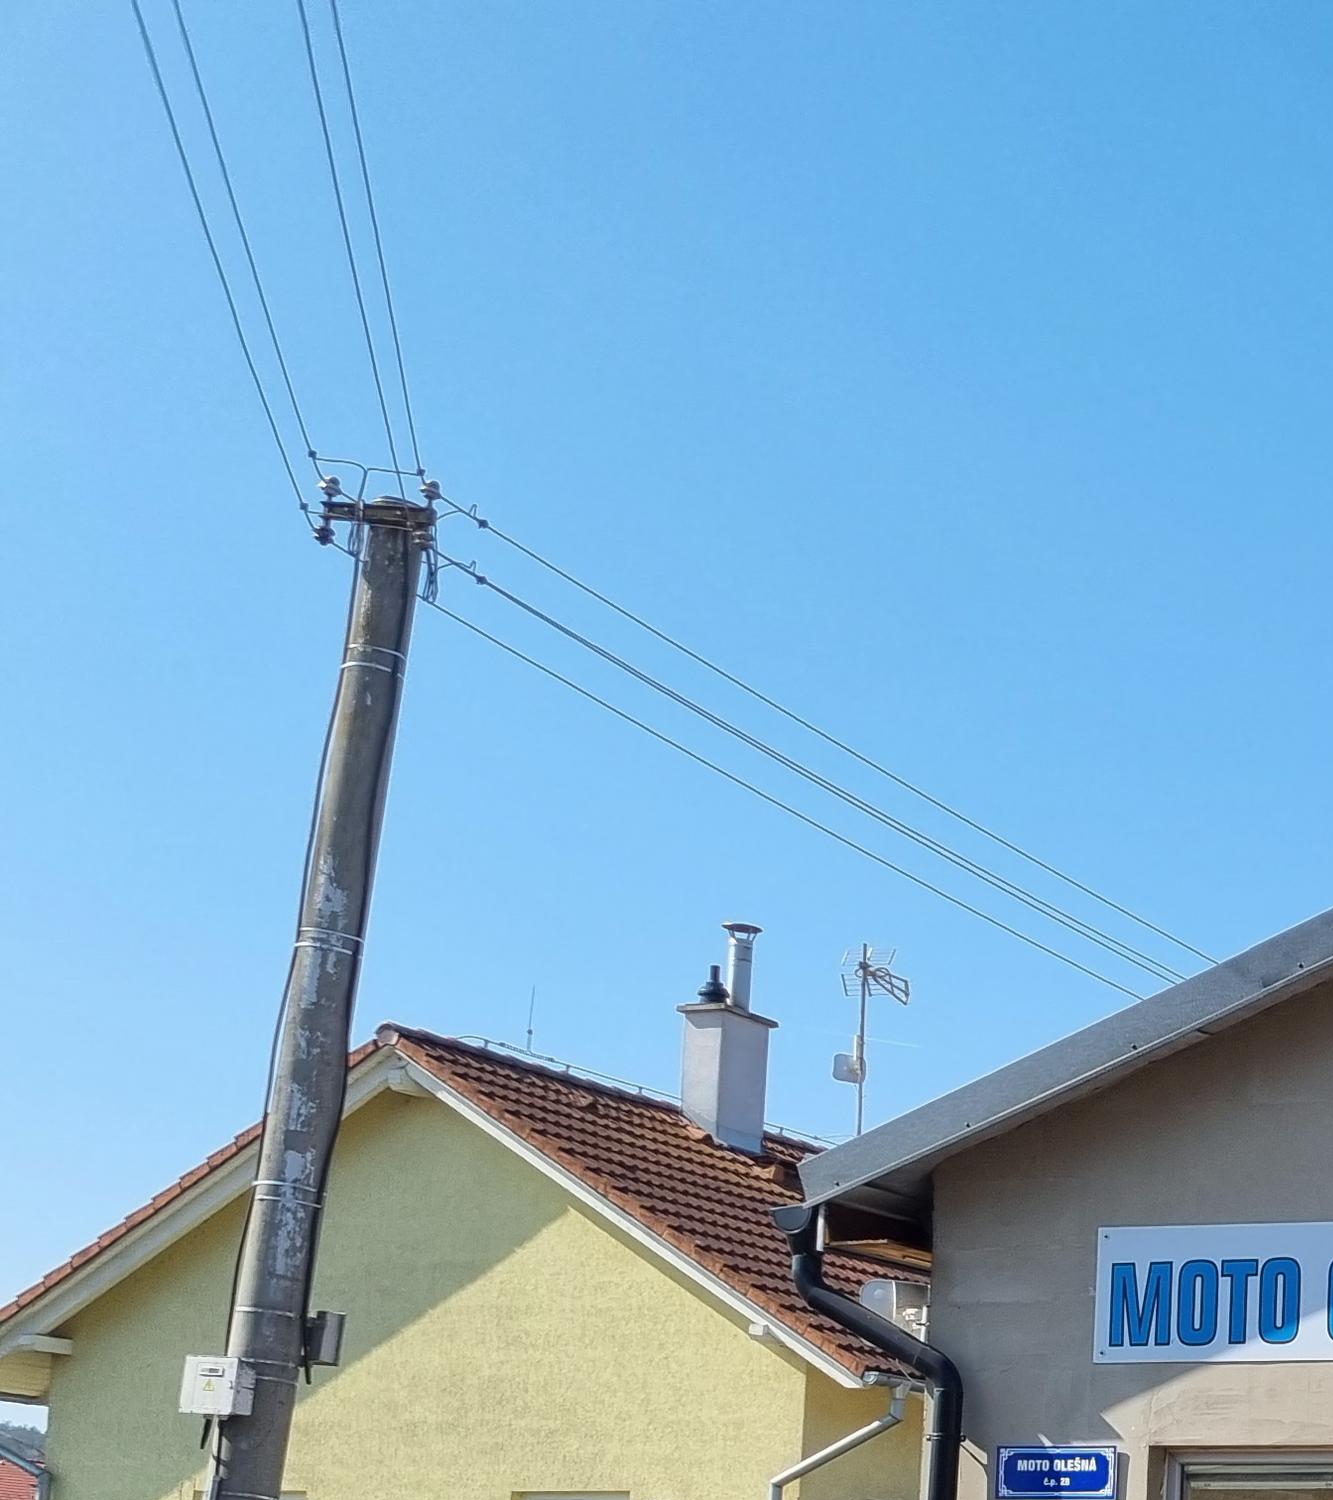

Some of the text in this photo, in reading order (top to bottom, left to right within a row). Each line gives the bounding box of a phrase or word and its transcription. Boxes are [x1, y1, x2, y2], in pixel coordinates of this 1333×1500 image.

[1109, 1257, 1301, 1347] MOTO
[1017, 1456, 1097, 1471] MOTO OLEŠNÁ
[1043, 1477, 1058, 1487] č.p.
